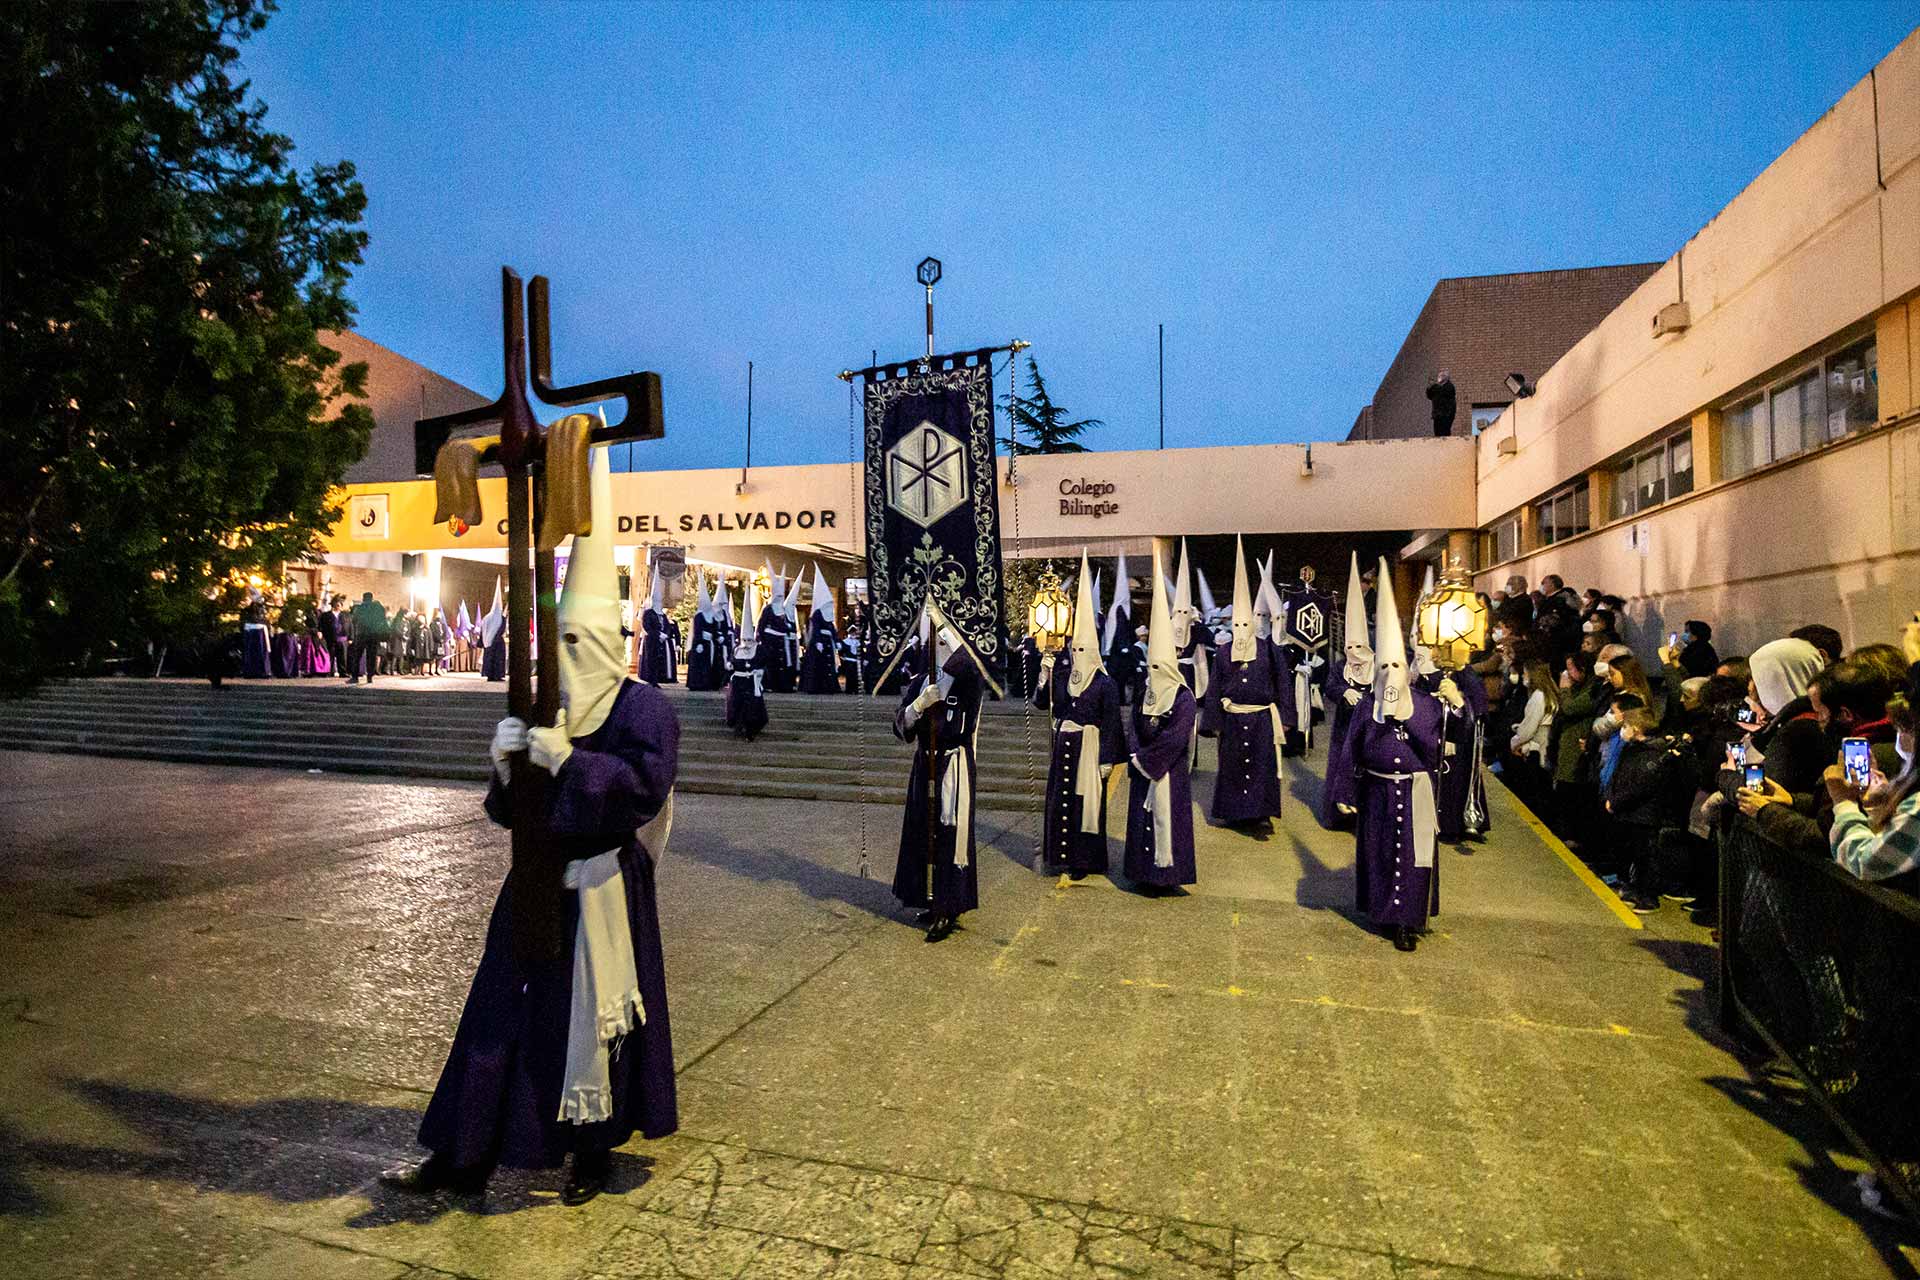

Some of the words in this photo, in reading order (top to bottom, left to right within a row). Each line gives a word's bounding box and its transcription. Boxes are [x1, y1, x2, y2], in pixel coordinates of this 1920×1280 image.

[1059, 477, 1115, 498] Colegio
[1059, 498, 1120, 519] Bilingüe
[618, 515, 668, 532] DEL
[679, 510, 837, 531] SALVADOR
